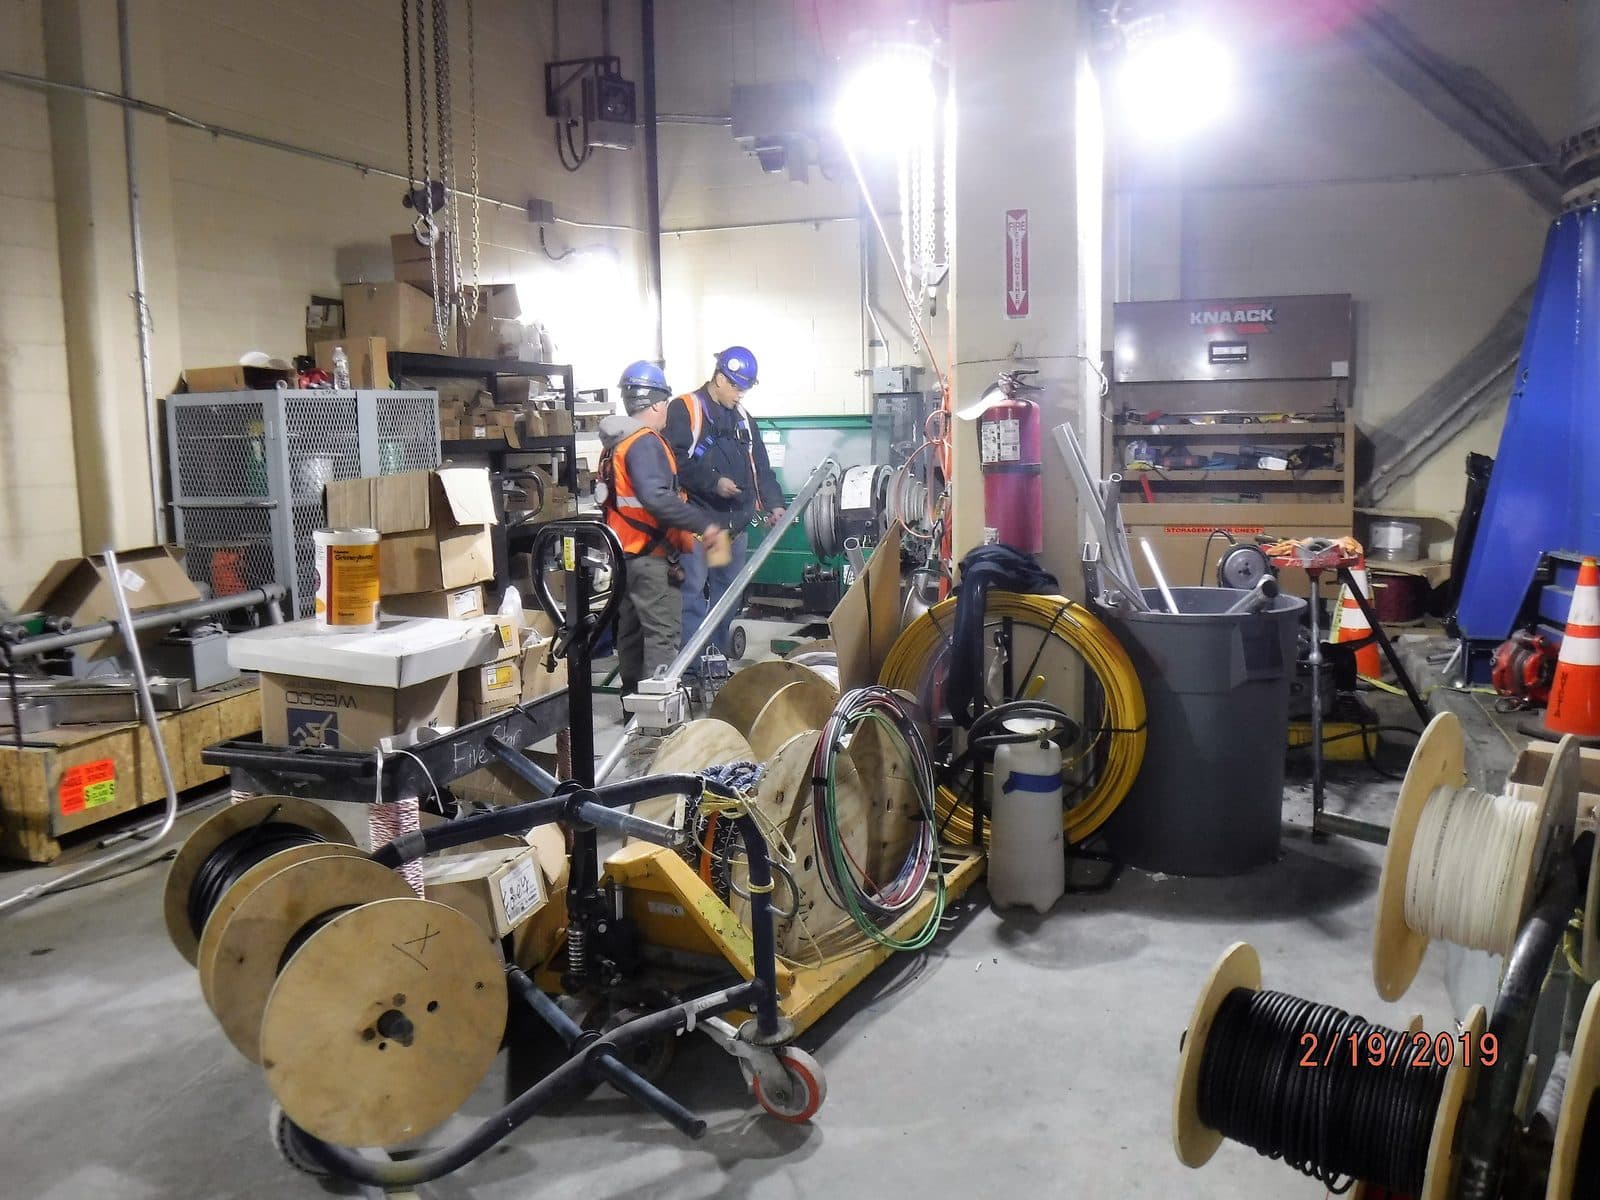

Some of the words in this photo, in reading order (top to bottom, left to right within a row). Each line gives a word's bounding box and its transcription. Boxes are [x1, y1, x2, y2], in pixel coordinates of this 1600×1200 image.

[1190, 309, 1273, 325] KNAACK
[285, 690, 357, 709] WESCO
[453, 741, 489, 774] Five
